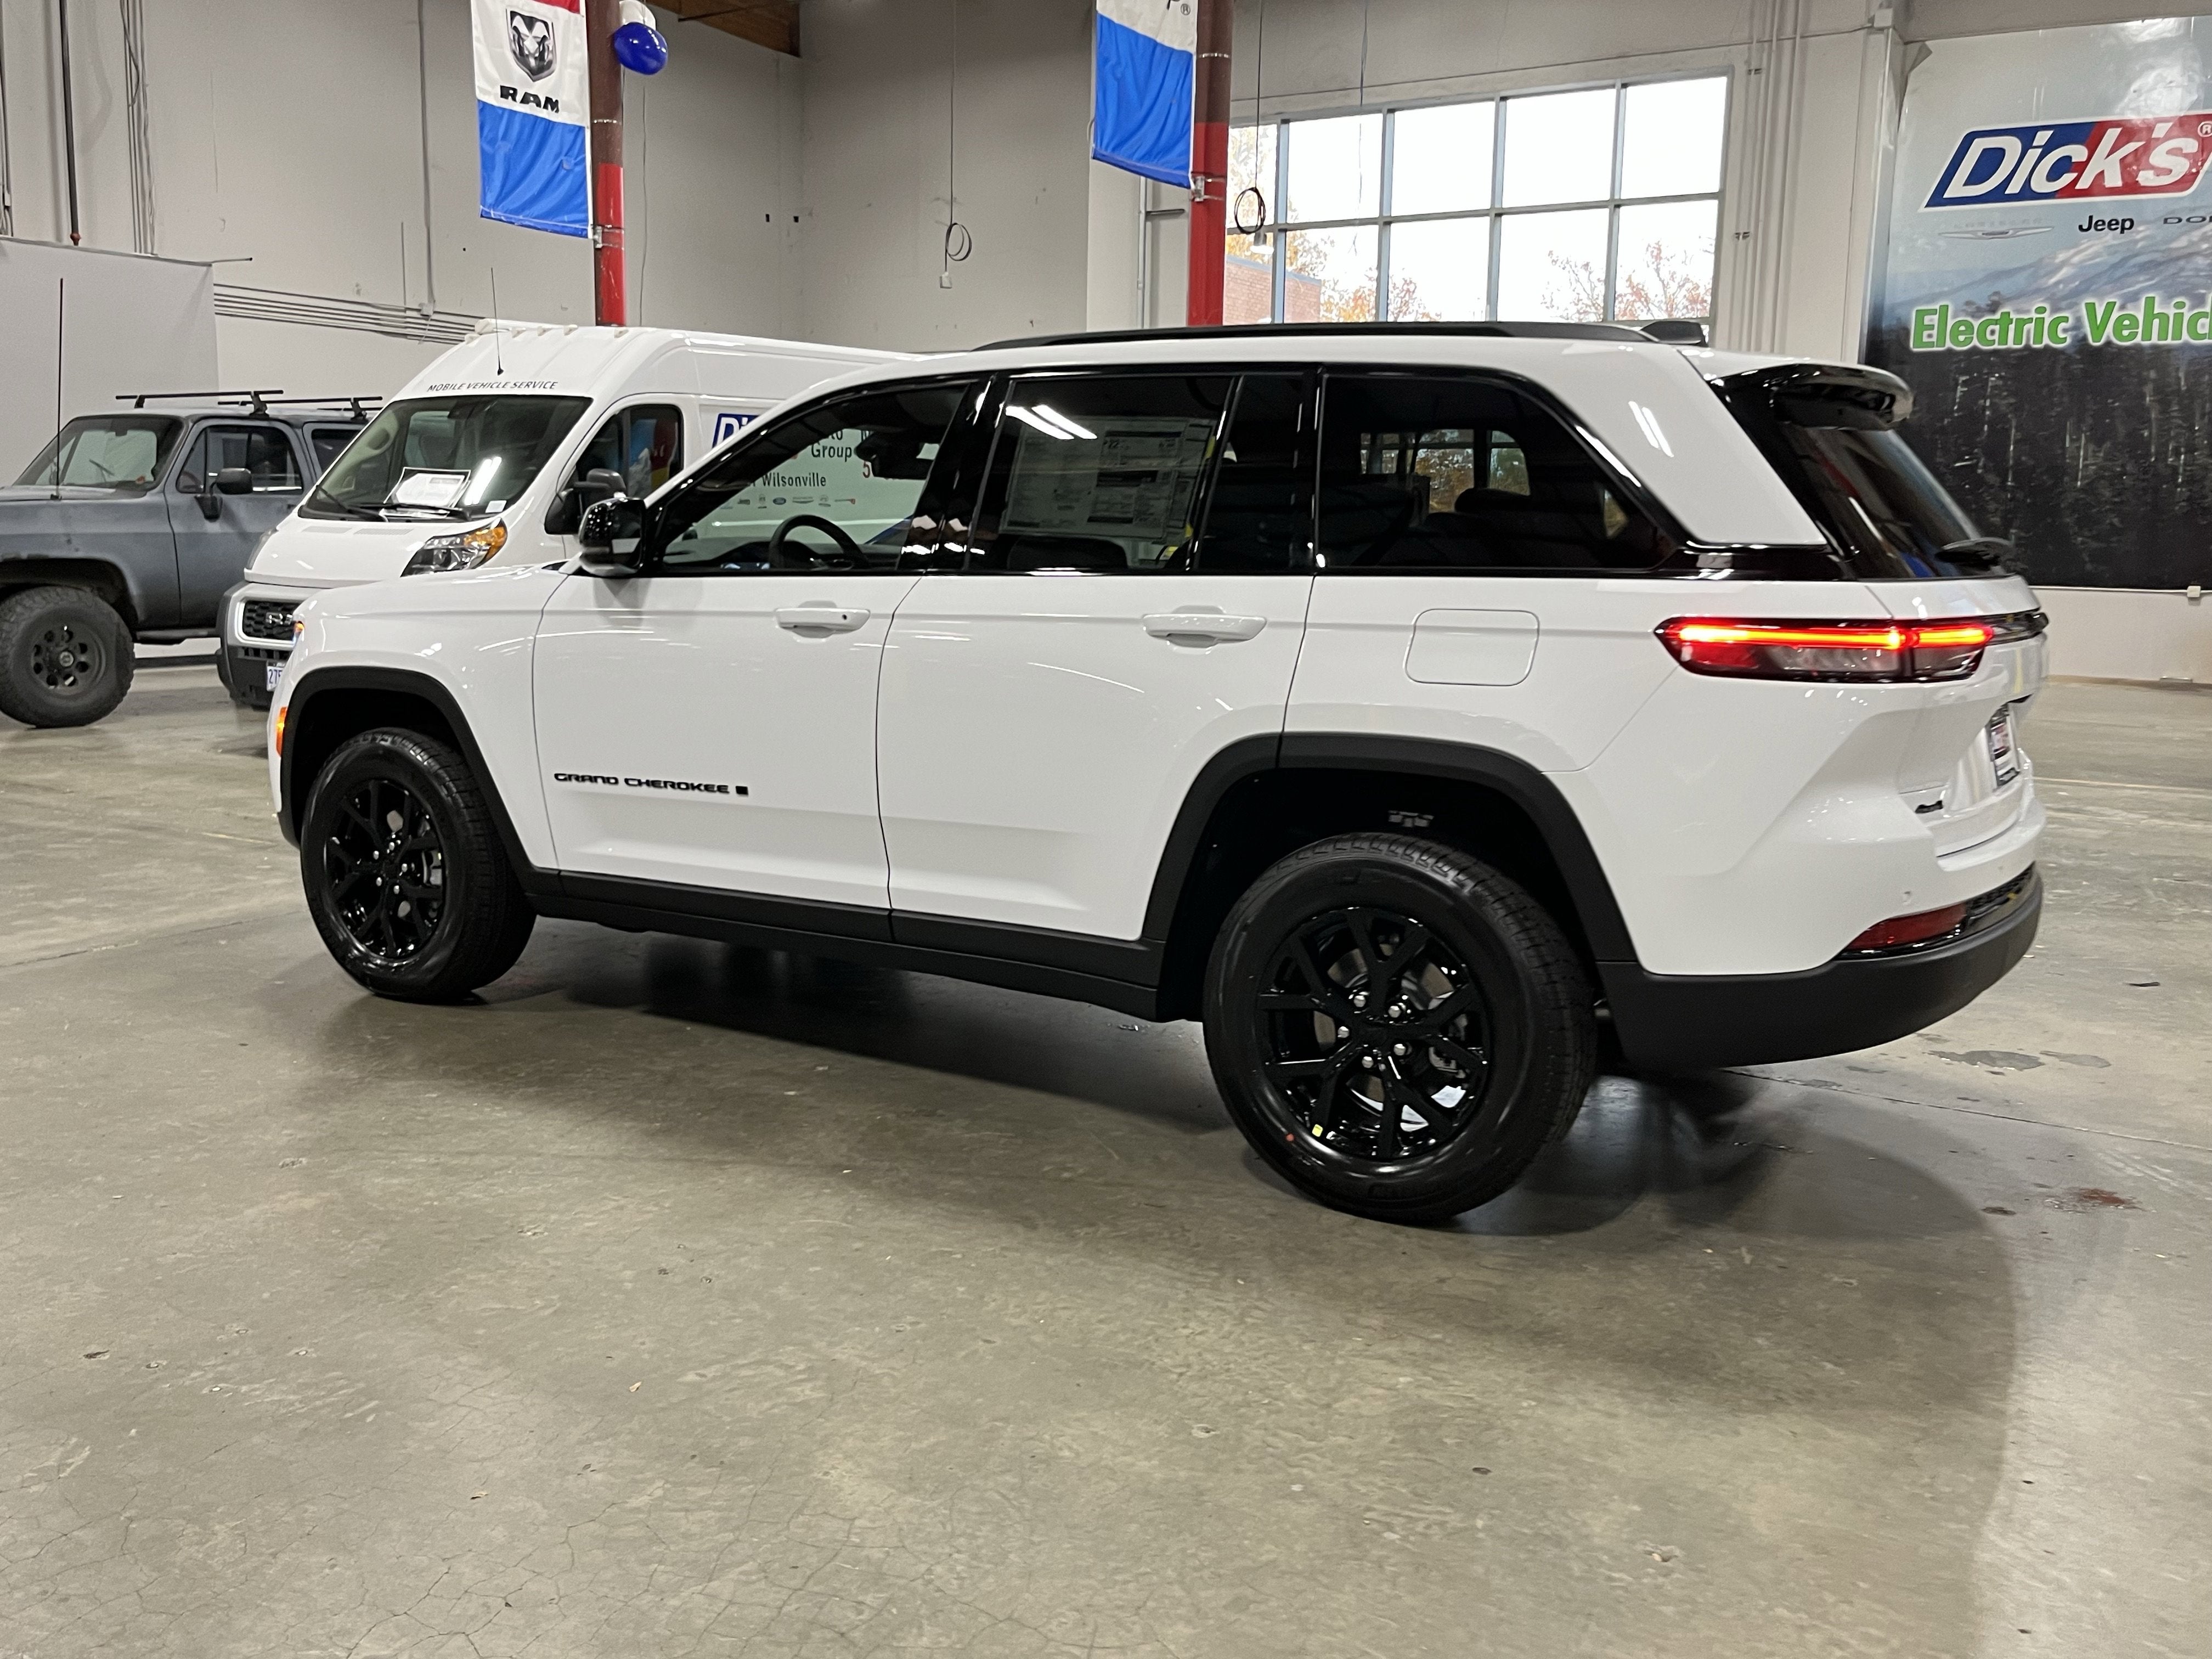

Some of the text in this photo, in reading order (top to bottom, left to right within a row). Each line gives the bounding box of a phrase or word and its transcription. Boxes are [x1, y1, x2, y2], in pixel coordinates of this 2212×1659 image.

[500, 85, 560, 113] RAM
[1943, 122, 2199, 199] Dick's
[2078, 215, 2212, 234] Jeep DO
[1912, 304, 2069, 349] Electric
[427, 383, 466, 392] MOBILE
[510, 381, 558, 390] SERVICE
[811, 441, 853, 462] Group
[762, 472, 826, 487] Wilsonville
[554, 772, 730, 794] GRAND CHEROKEE
